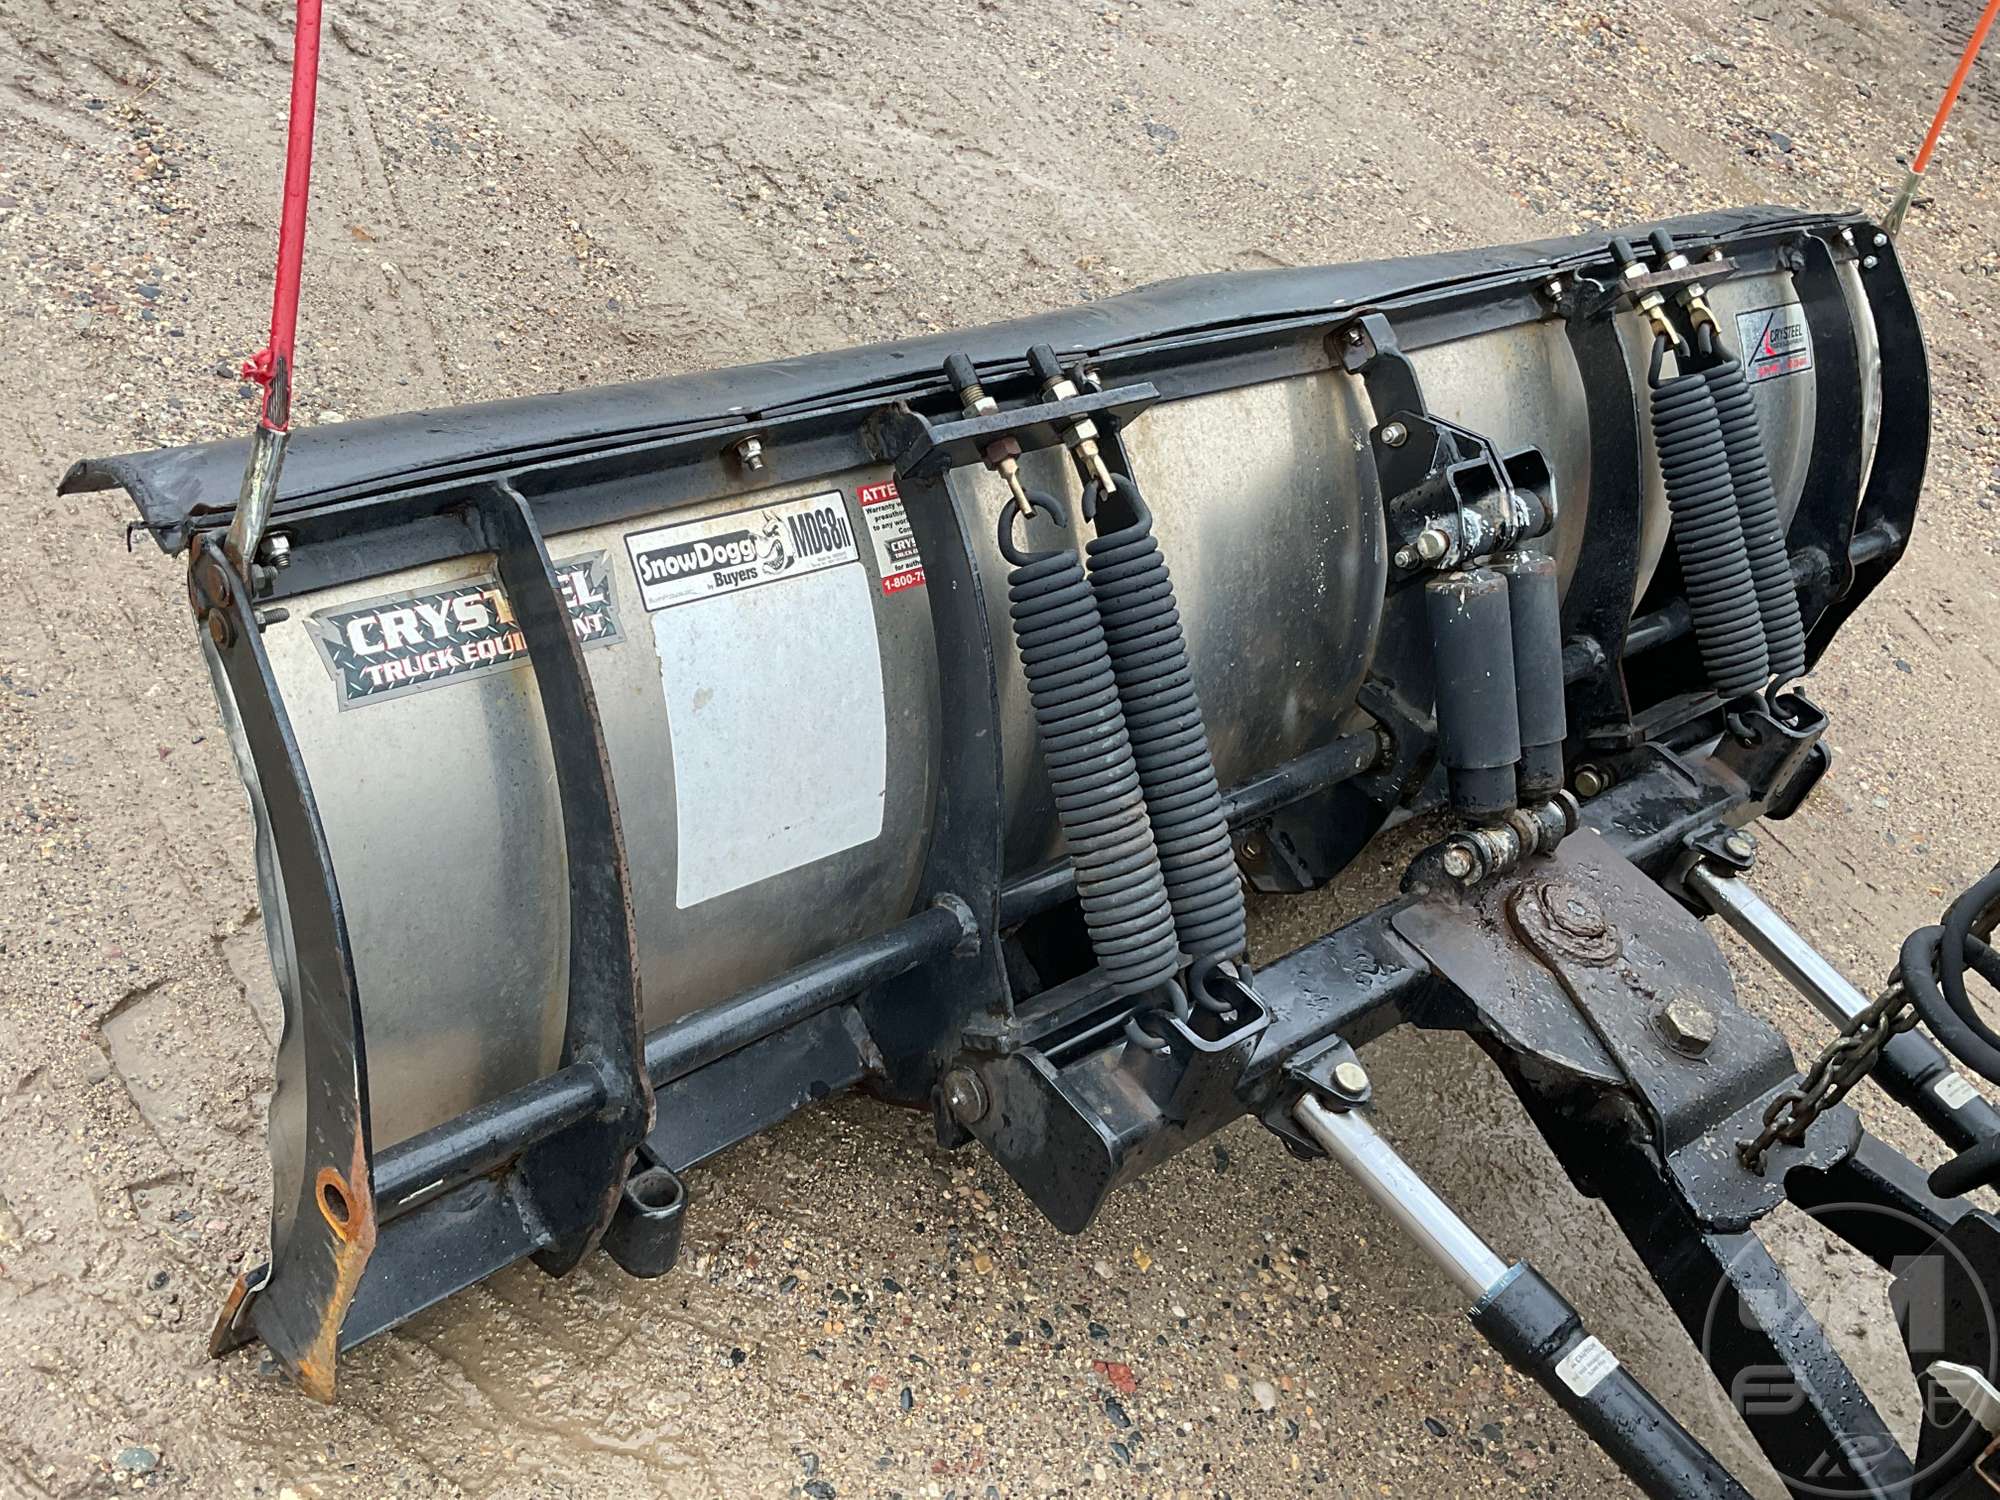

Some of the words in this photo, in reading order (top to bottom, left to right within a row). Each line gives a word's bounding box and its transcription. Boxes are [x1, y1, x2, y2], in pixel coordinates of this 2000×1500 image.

[1770, 324, 1802, 343] CRYSTEEL
[863, 483, 898, 502] ATTE
[865, 502, 895, 514] Warranty
[882, 521, 893, 529] any
[639, 540, 757, 582] SnowDogg
[895, 563, 904, 571] for
[713, 566, 758, 588] Buyers
[364, 647, 460, 687] TRUCK
